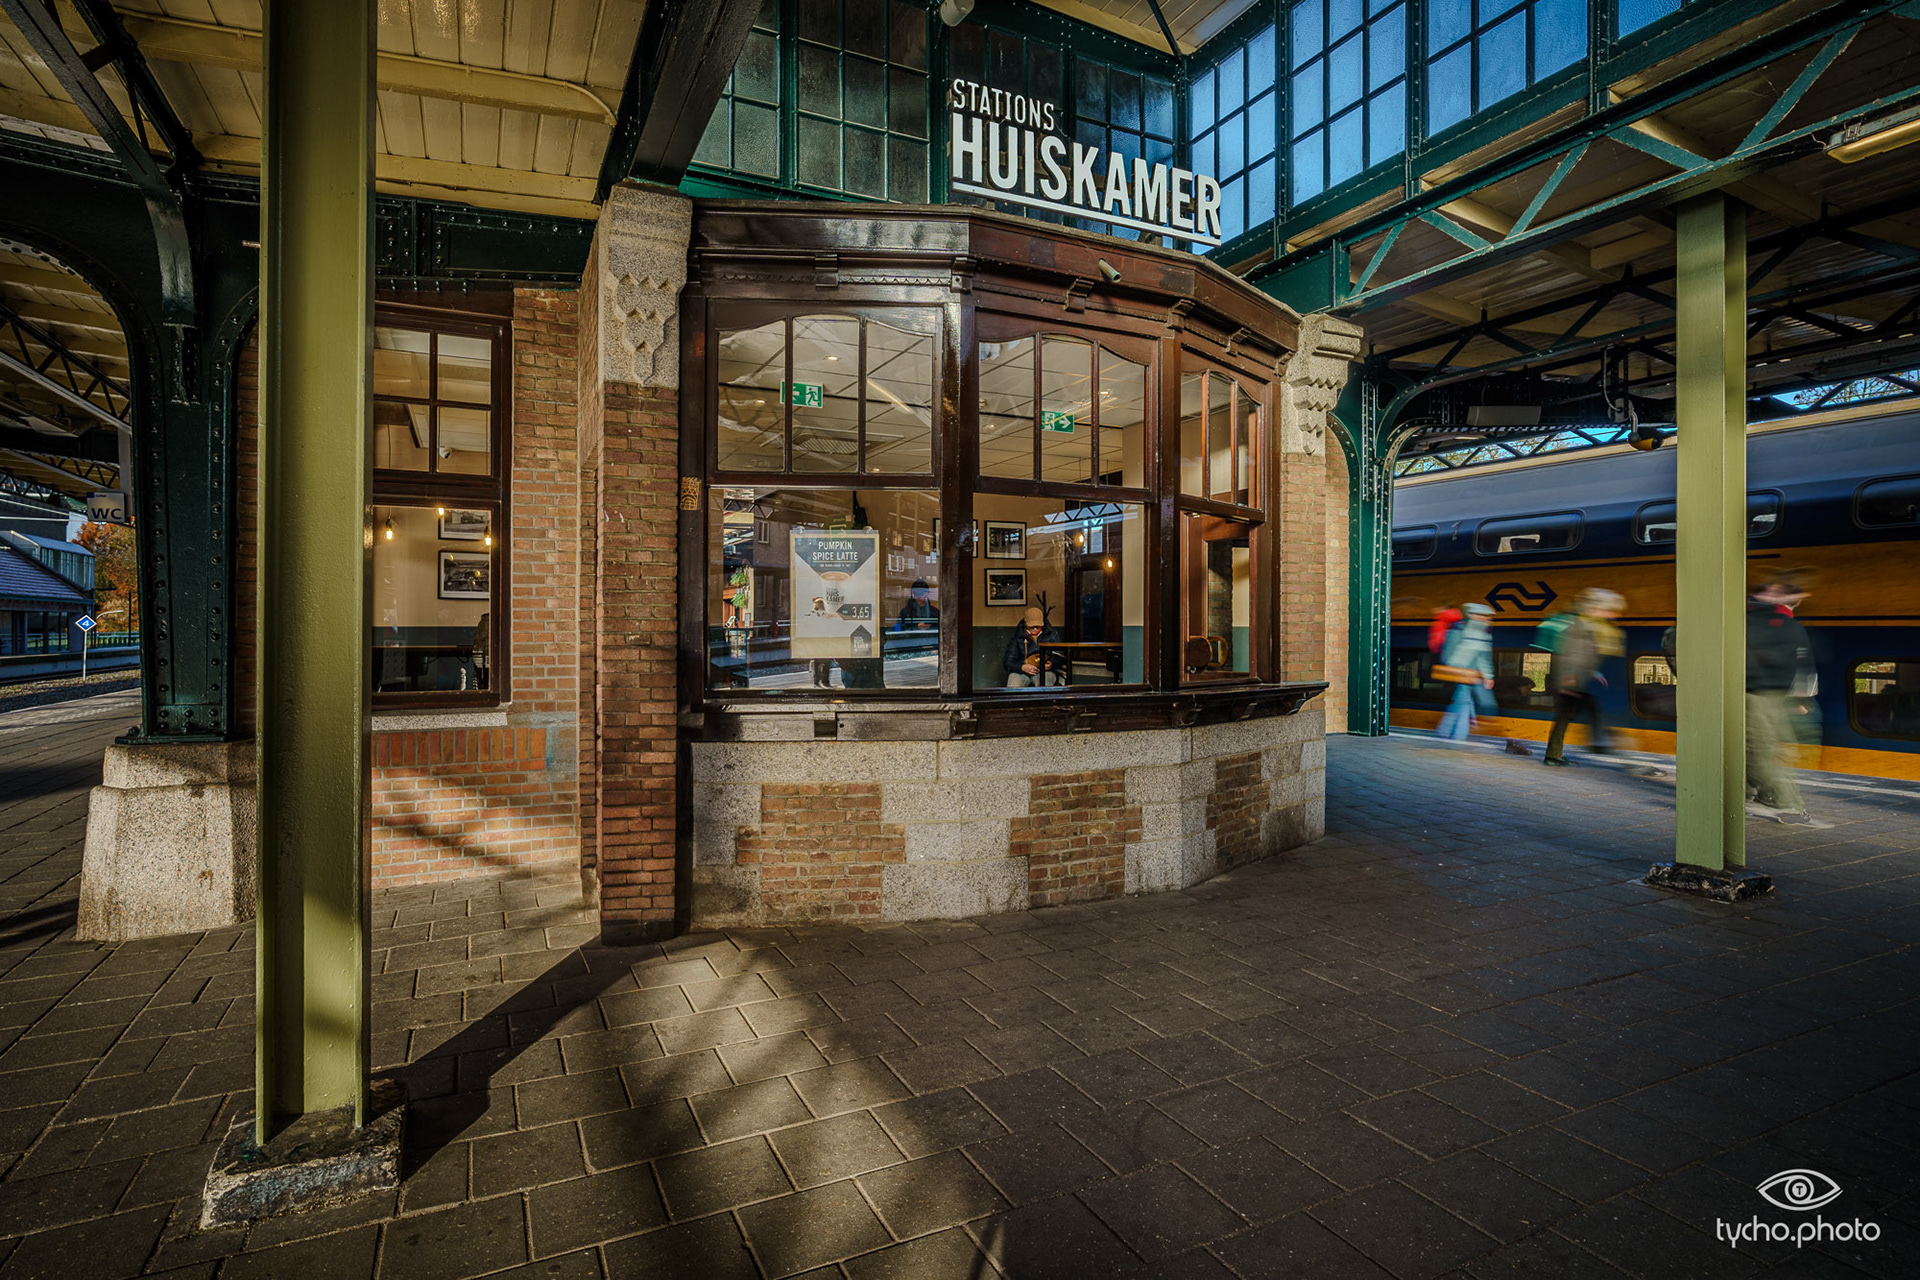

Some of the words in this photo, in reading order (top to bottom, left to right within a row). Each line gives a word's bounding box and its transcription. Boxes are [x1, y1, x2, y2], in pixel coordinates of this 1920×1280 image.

[952, 78, 1055, 131] STATIONS
[951, 112, 1222, 238] HUISKAMER
[91, 507, 122, 520] WC
[818, 541, 853, 550] PUMPKIN
[812, 551, 834, 561] SPICE
[836, 551, 858, 561] LATTE
[852, 606, 870, 618] 3.65
